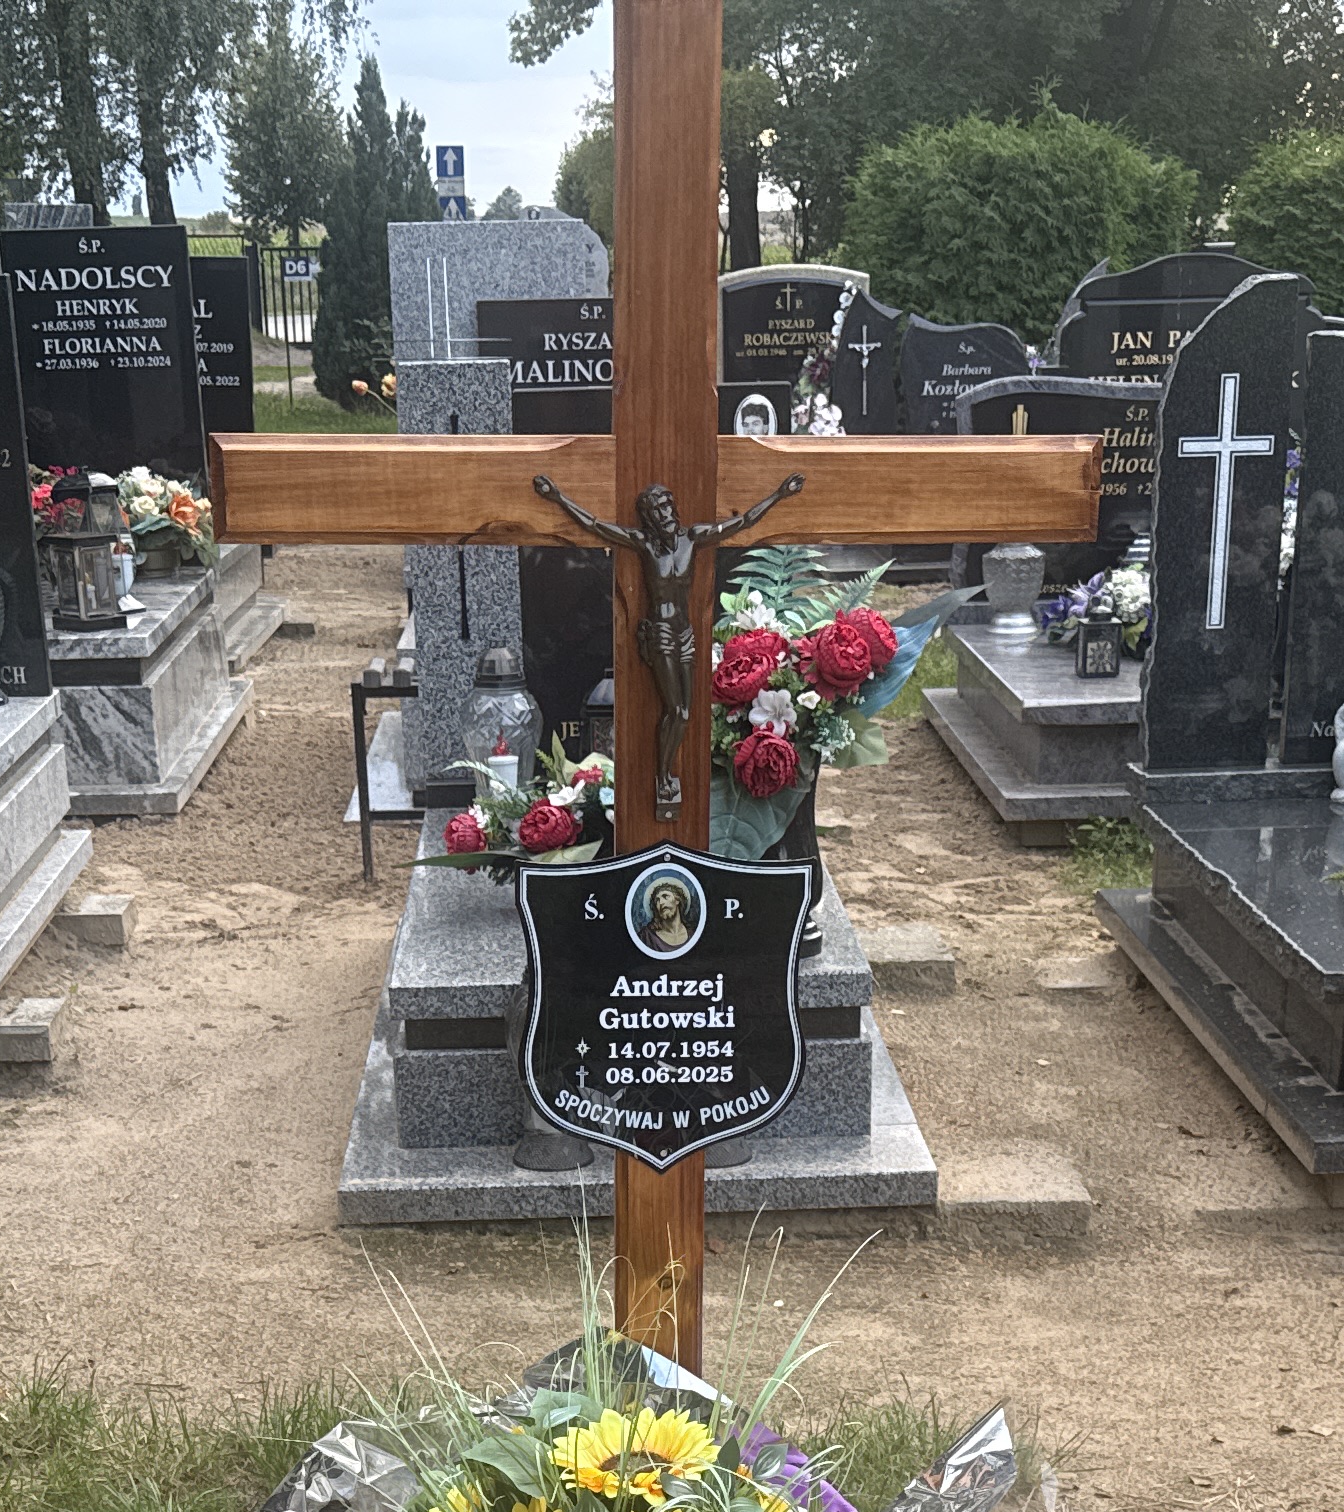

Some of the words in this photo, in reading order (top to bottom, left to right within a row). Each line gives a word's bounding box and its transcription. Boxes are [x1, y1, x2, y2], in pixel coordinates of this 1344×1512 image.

[78, 236, 106, 254] Ś.P.
[285, 259, 307, 275] D6
[14, 264, 174, 292] NADOLSCY
[55, 297, 140, 317] HENRYK
[580, 303, 606, 320] Ś.P.
[41, 319, 97, 332] 18.05.1935
[113, 317, 168, 330] 14.05.2020
[768, 319, 815, 330] RYSZARD
[43, 335, 163, 355] FLORIANNA
[1110, 330, 1154, 354] JAN
[44, 358, 100, 371] 27.03.1936
[116, 355, 172, 369] 23.10.2024
[942, 363, 992, 377] Barbara
[1125, 405, 1150, 422] Ś.P.
[561, 721, 585, 742] JE
[584, 893, 605, 920] Ś.
[724, 898, 744, 919] P.
[609, 973, 725, 1002] Andrzej
[598, 1005, 736, 1030] Gutowski
[607, 1040, 735, 1060] 14.07.1954
[605, 1065, 734, 1084] 08.06.2025
[554, 1088, 664, 1131] SPOCZYWAJ
[673, 1109, 691, 1130] W
[699, 1085, 772, 1127] POKOJU
